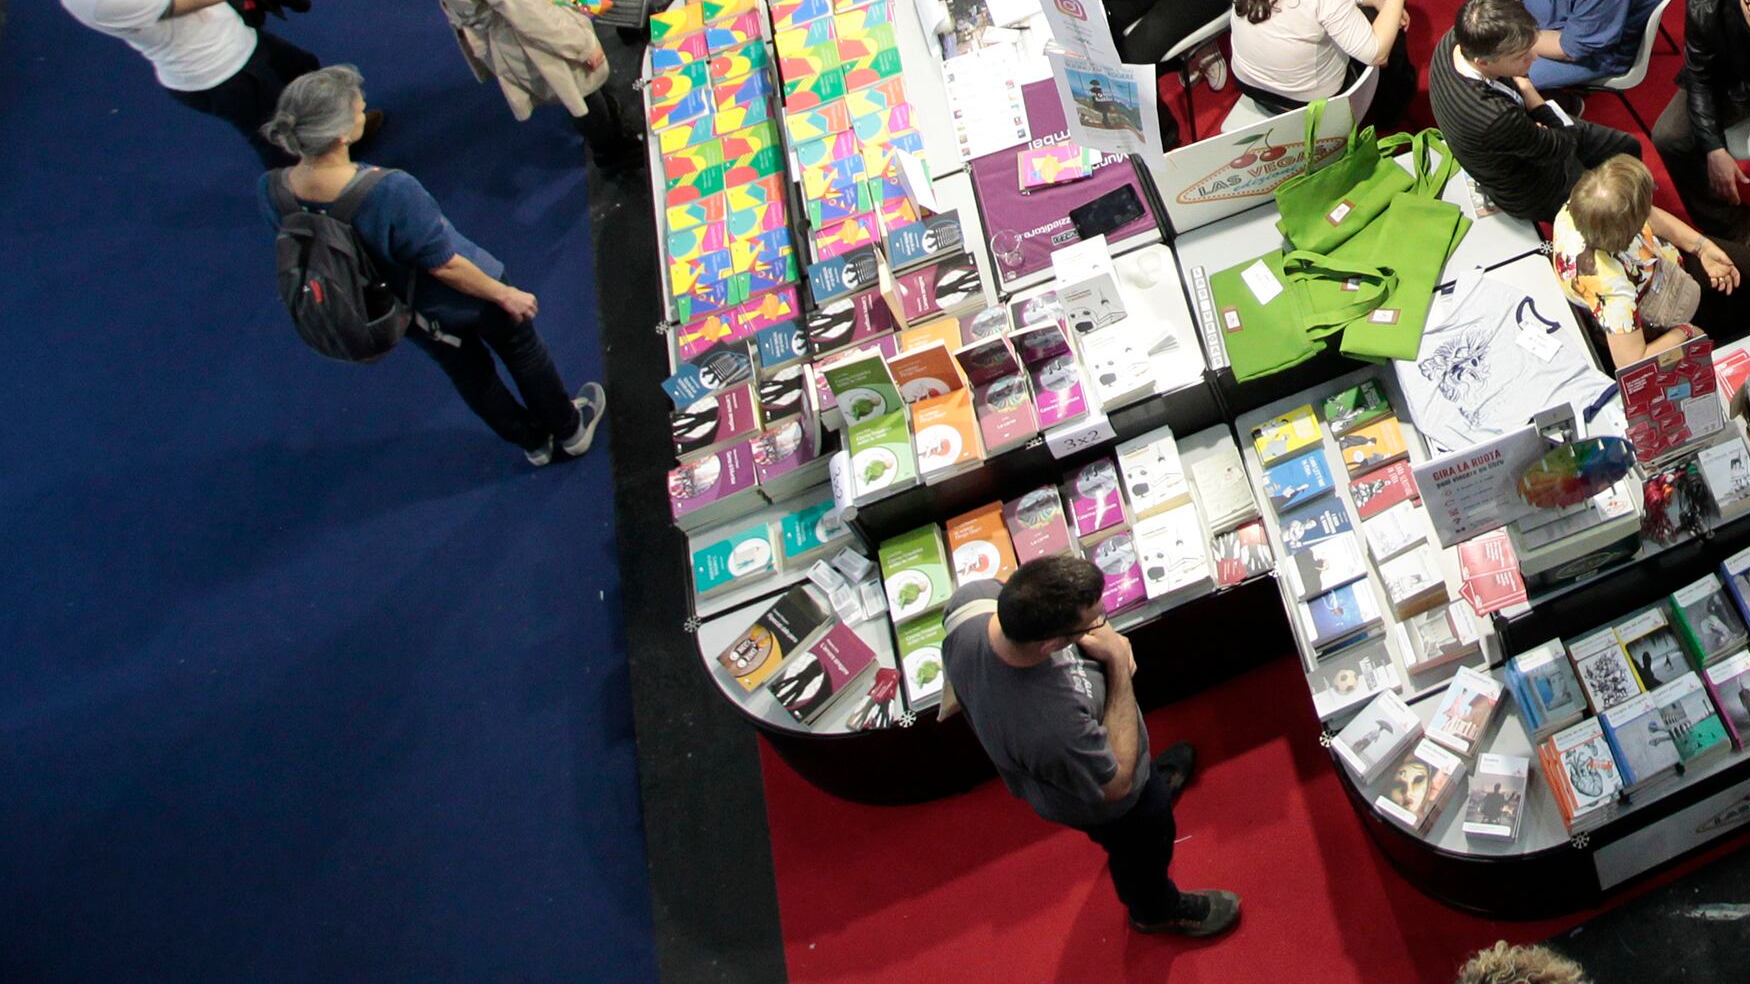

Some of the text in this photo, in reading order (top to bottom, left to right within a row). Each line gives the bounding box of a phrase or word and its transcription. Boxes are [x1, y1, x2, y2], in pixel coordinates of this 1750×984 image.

[1197, 174, 1243, 197] LAS
[1062, 429, 1099, 452] 3x2
[1432, 449, 1502, 482] GIRA LA RUOTA
